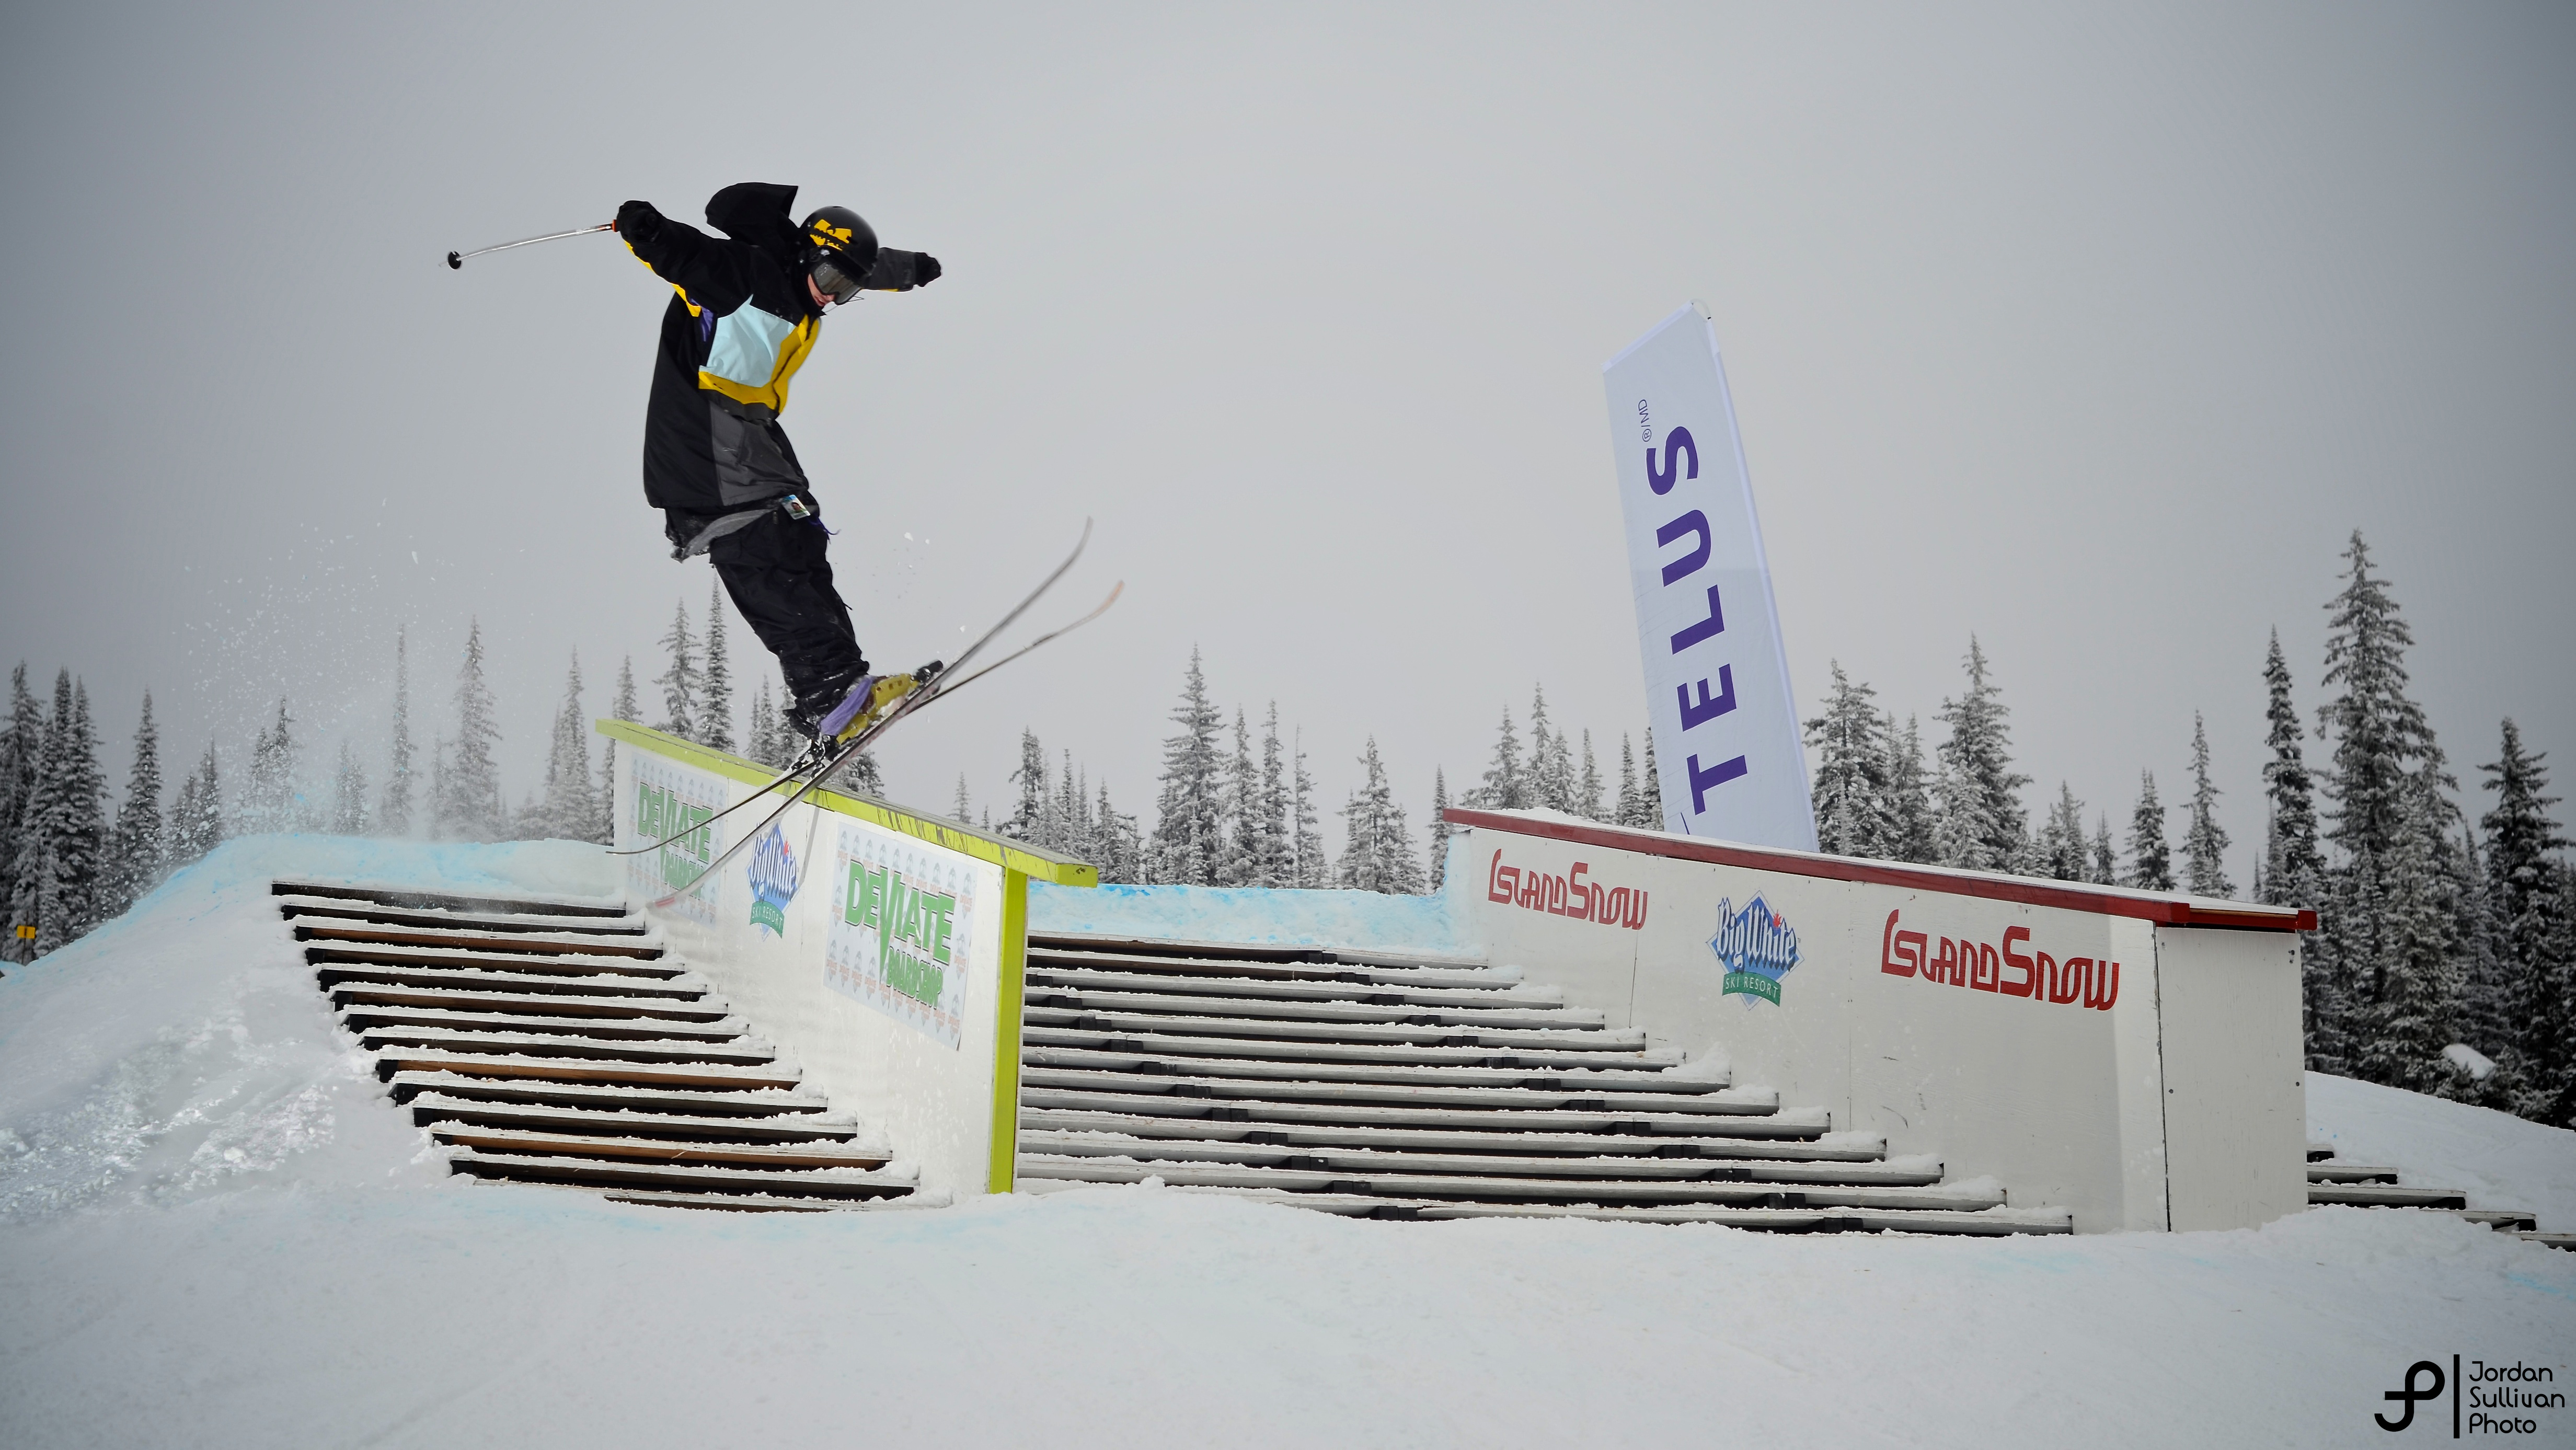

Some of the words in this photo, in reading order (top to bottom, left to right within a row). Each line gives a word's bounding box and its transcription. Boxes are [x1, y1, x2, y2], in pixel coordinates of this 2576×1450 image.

[1646, 426, 1748, 815] TELUS
[638, 782, 713, 881] DEVIATE
[845, 859, 956, 984] DEVIATE
[1726, 977, 1739, 989] SKI
[1744, 976, 1778, 998] RESORT
